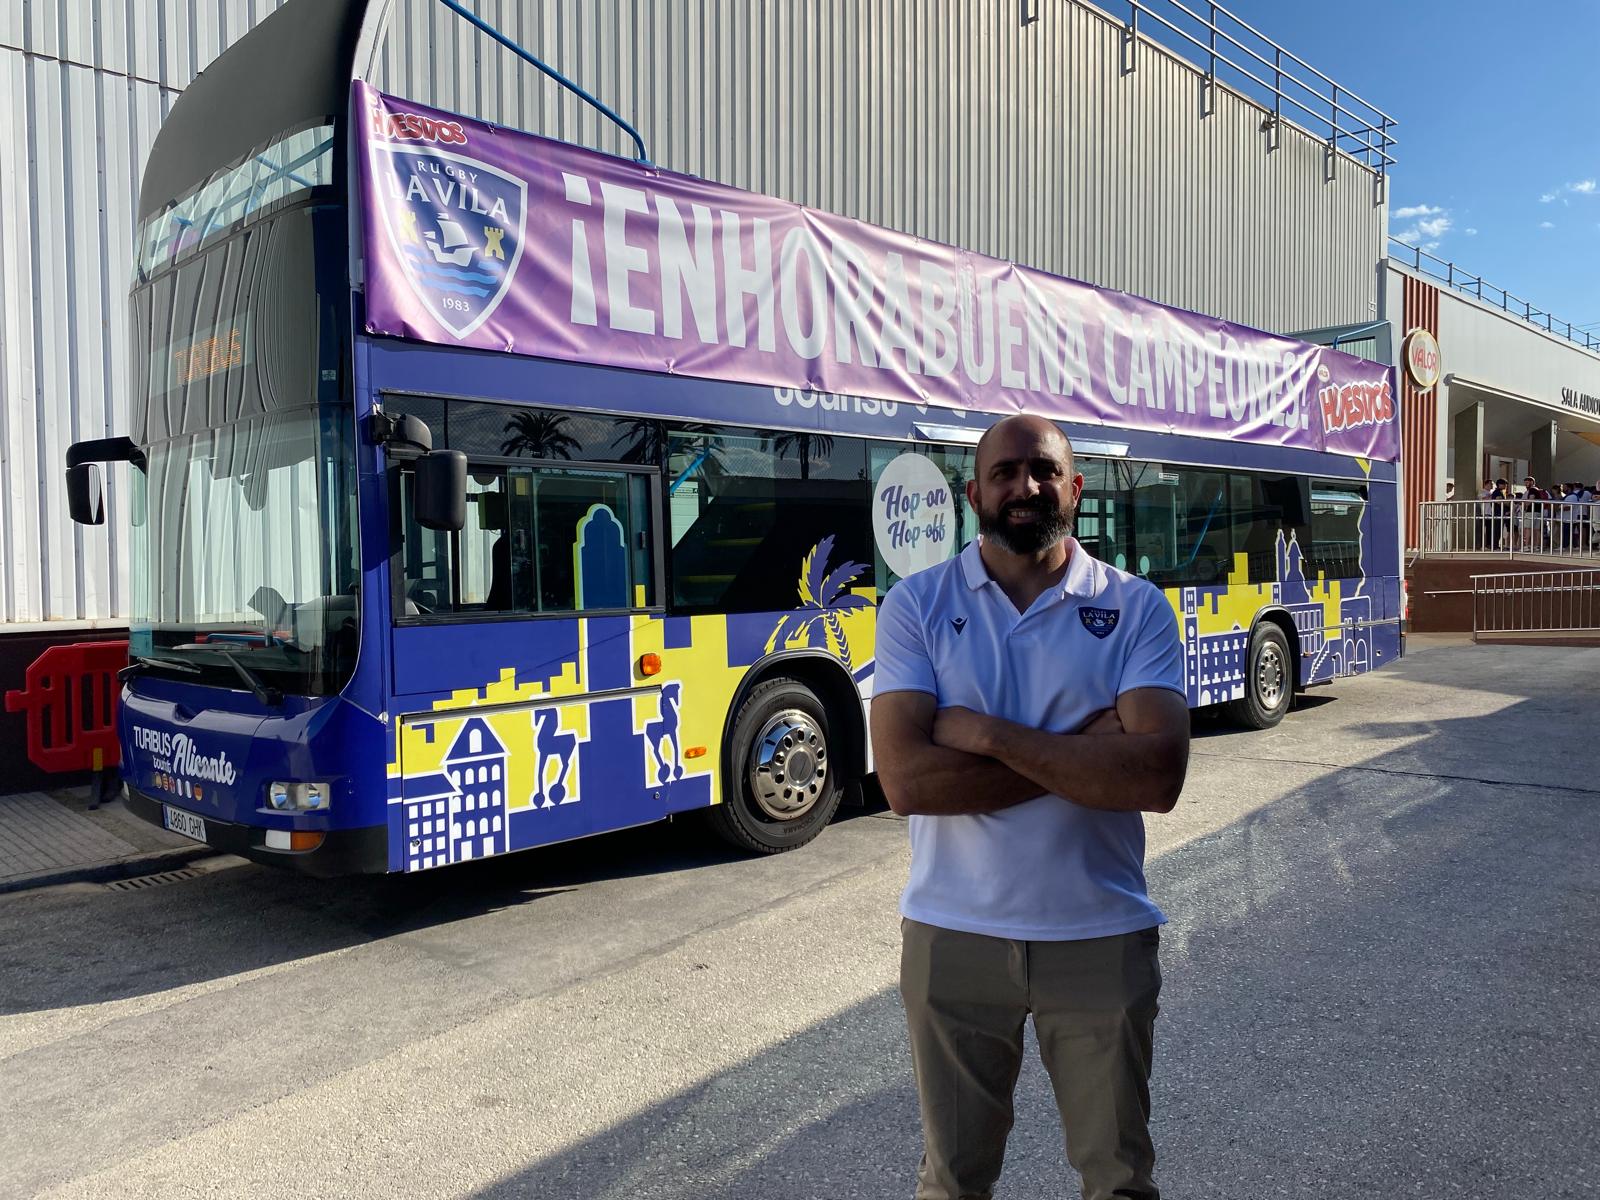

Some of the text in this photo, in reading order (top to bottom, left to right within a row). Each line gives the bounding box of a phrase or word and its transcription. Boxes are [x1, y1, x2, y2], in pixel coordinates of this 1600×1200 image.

[417, 160, 478, 184] RUGBY
[442, 298, 471, 312] 1983
[1104, 310, 1309, 430] CAMPEONES!
[1411, 347, 1438, 371] VALOR
[1319, 380, 1393, 434] HUESITOS
[1561, 386, 1579, 409] SALA
[880, 485, 947, 520] Hop-on
[887, 512, 946, 550] Hop-off
[133, 725, 236, 786] TURIBUS Alicante
